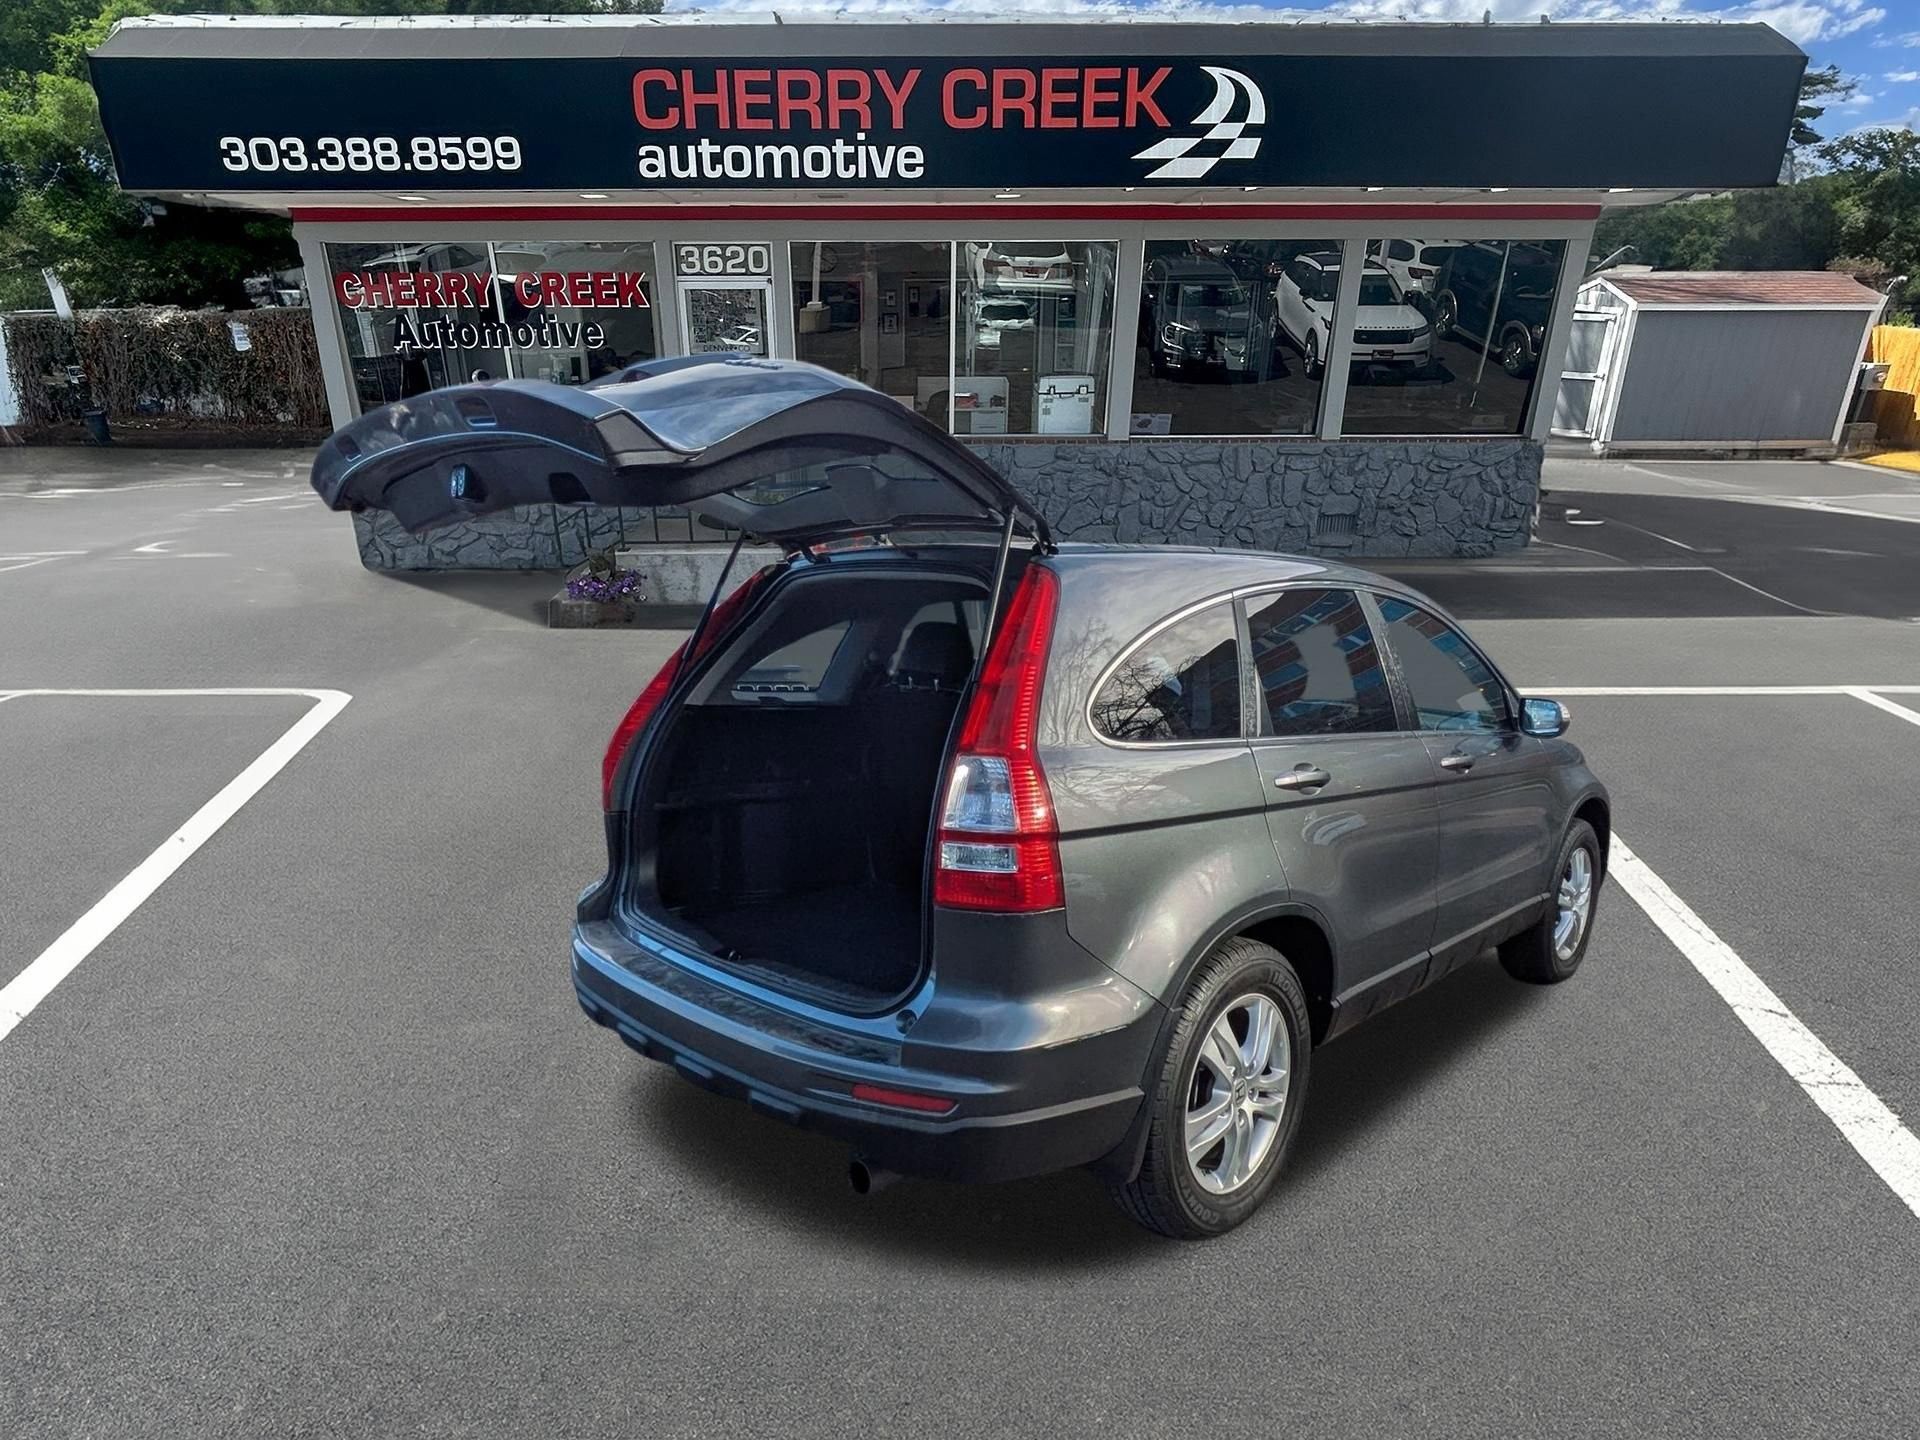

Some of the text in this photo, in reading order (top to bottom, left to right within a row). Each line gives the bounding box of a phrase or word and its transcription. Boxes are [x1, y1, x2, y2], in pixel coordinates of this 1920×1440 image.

[632, 67, 1173, 130] CHERRY CREEK
[219, 135, 522, 172] 303.388.8599
[637, 132, 925, 179] automotive
[680, 245, 769, 274] 3620
[335, 271, 650, 308] CHERRY CREEK
[393, 313, 605, 350] Automotive
